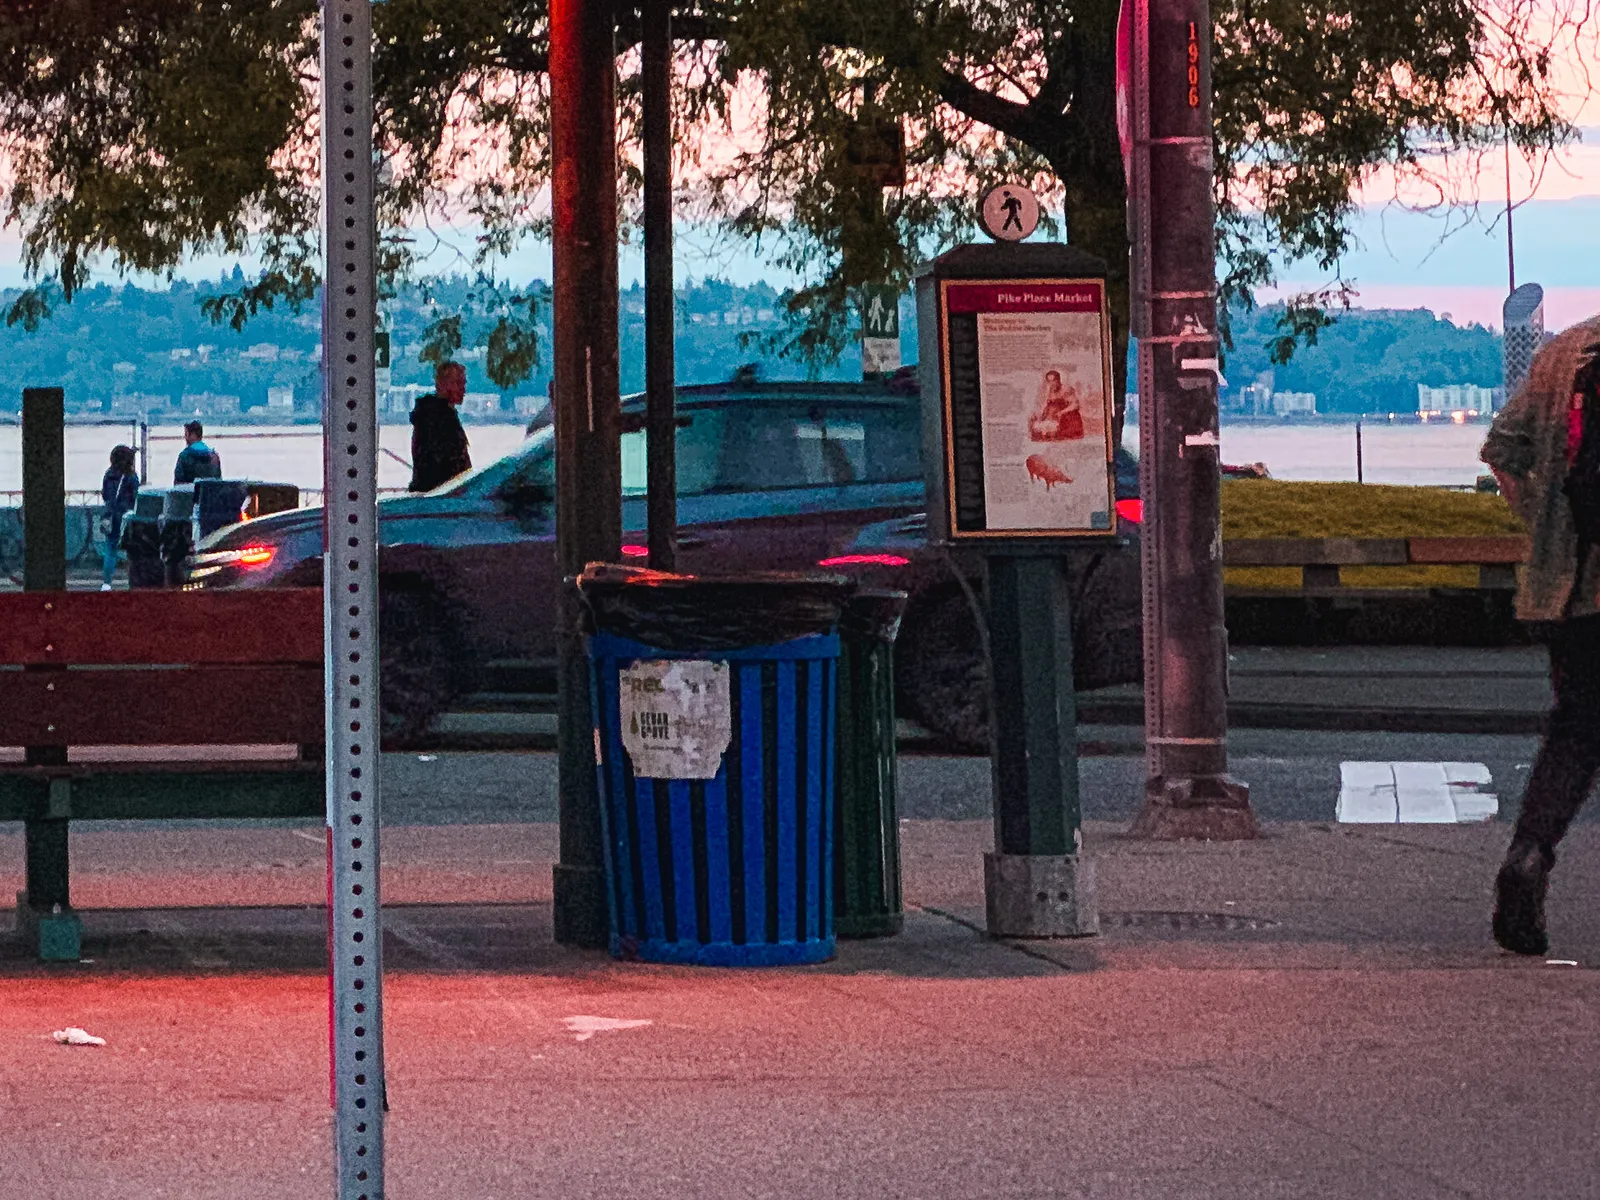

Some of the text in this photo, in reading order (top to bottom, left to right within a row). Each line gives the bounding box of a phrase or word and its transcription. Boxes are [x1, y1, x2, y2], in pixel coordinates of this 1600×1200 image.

[1187, 21, 1199, 107] 1906
[997, 291, 1093, 304] Pike Place Market
